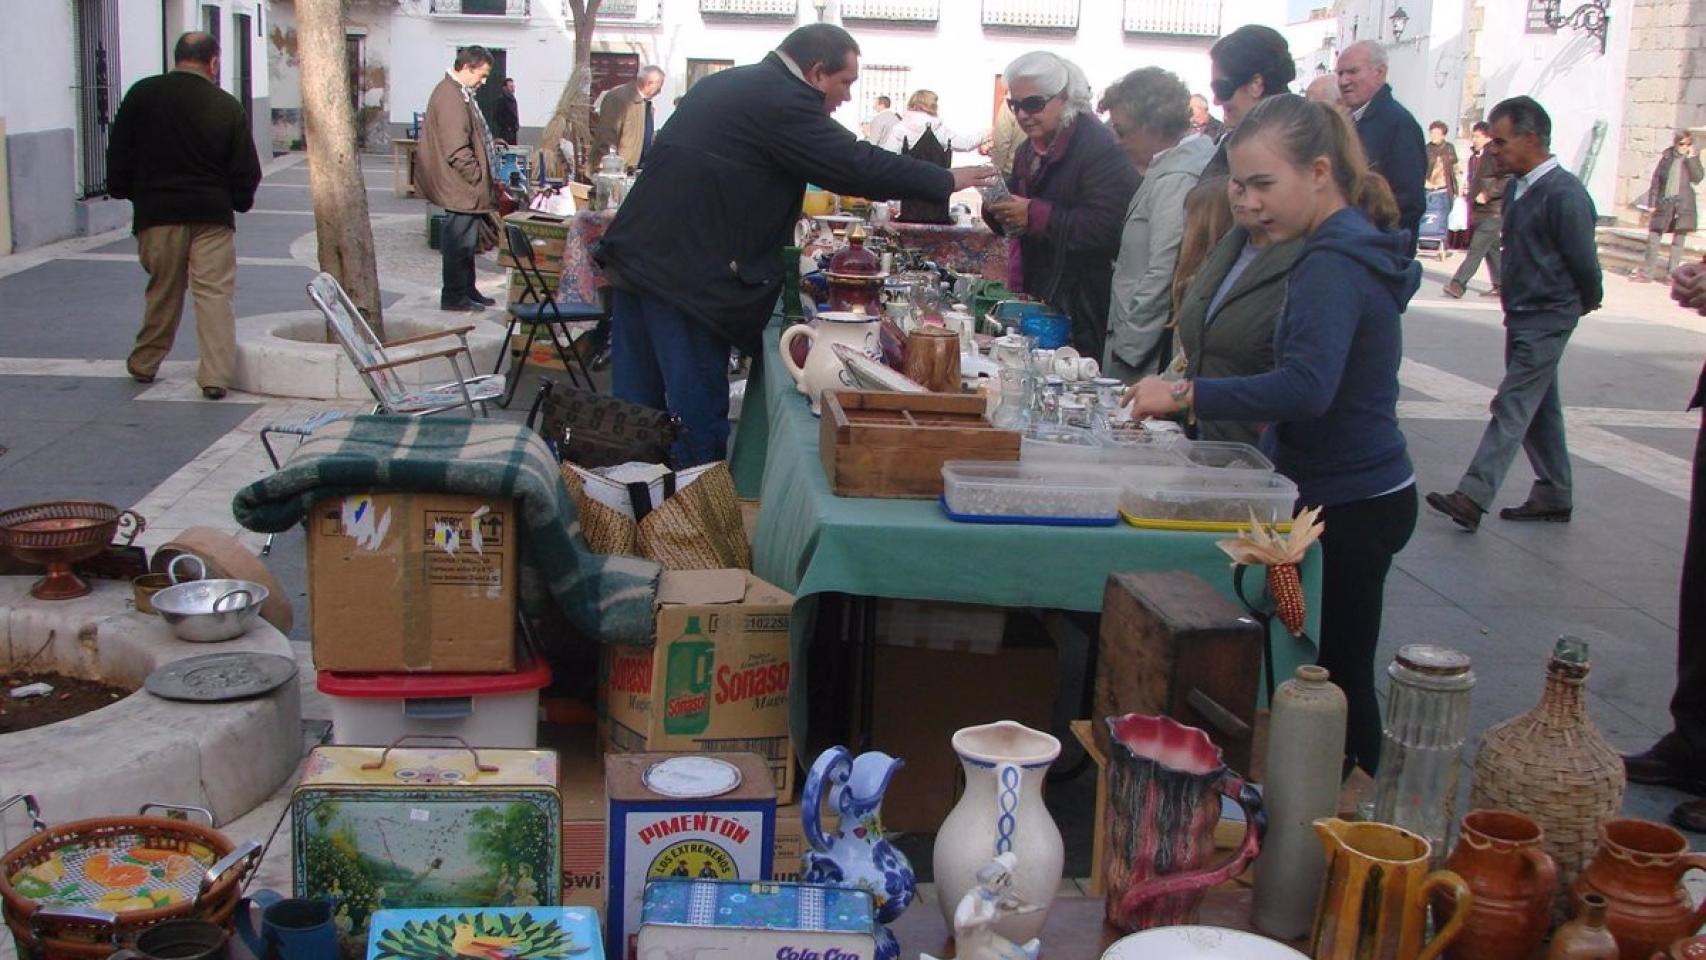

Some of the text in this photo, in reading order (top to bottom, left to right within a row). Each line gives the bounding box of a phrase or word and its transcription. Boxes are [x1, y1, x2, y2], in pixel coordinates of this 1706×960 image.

[655, 855, 673, 873] LOS
[776, 946, 860, 960] Cola Cao
